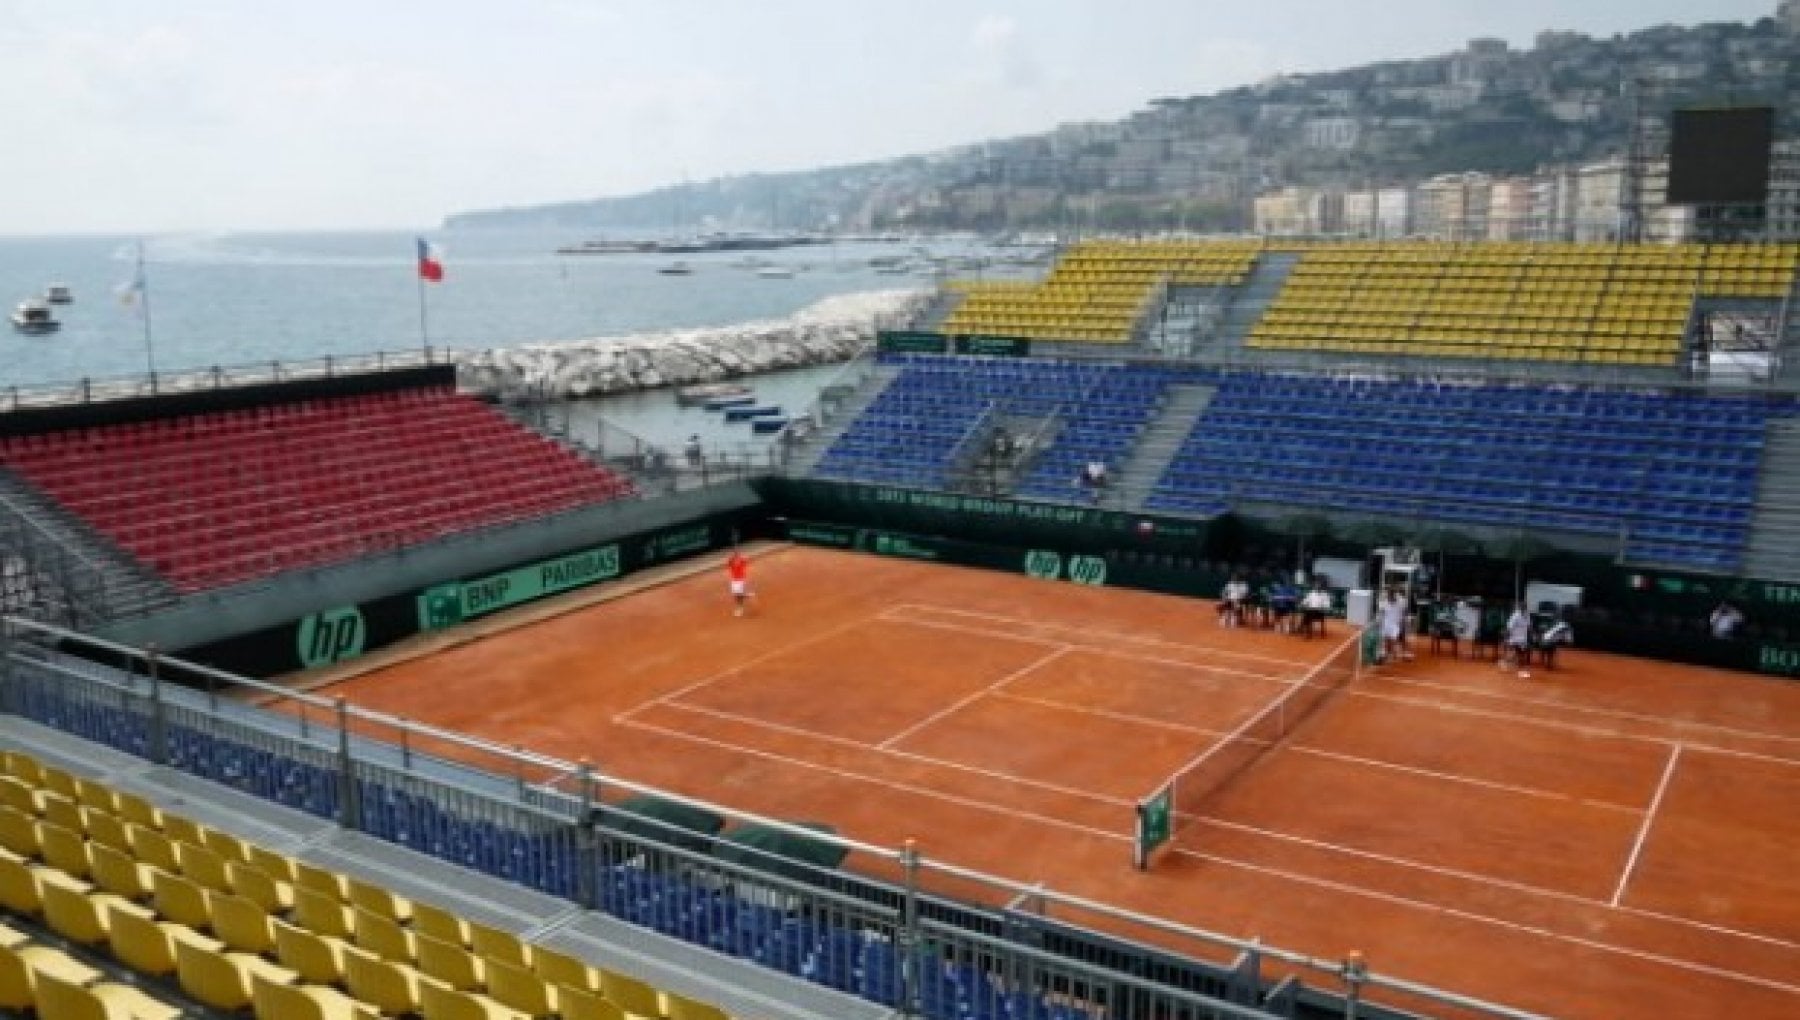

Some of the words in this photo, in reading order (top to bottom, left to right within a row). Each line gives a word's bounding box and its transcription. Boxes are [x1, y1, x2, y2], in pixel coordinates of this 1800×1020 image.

[467, 577, 510, 611] BNP
[540, 549, 618, 589] PARIBAS
[1074, 557, 1102, 584] hp
[308, 612, 359, 664] hp
